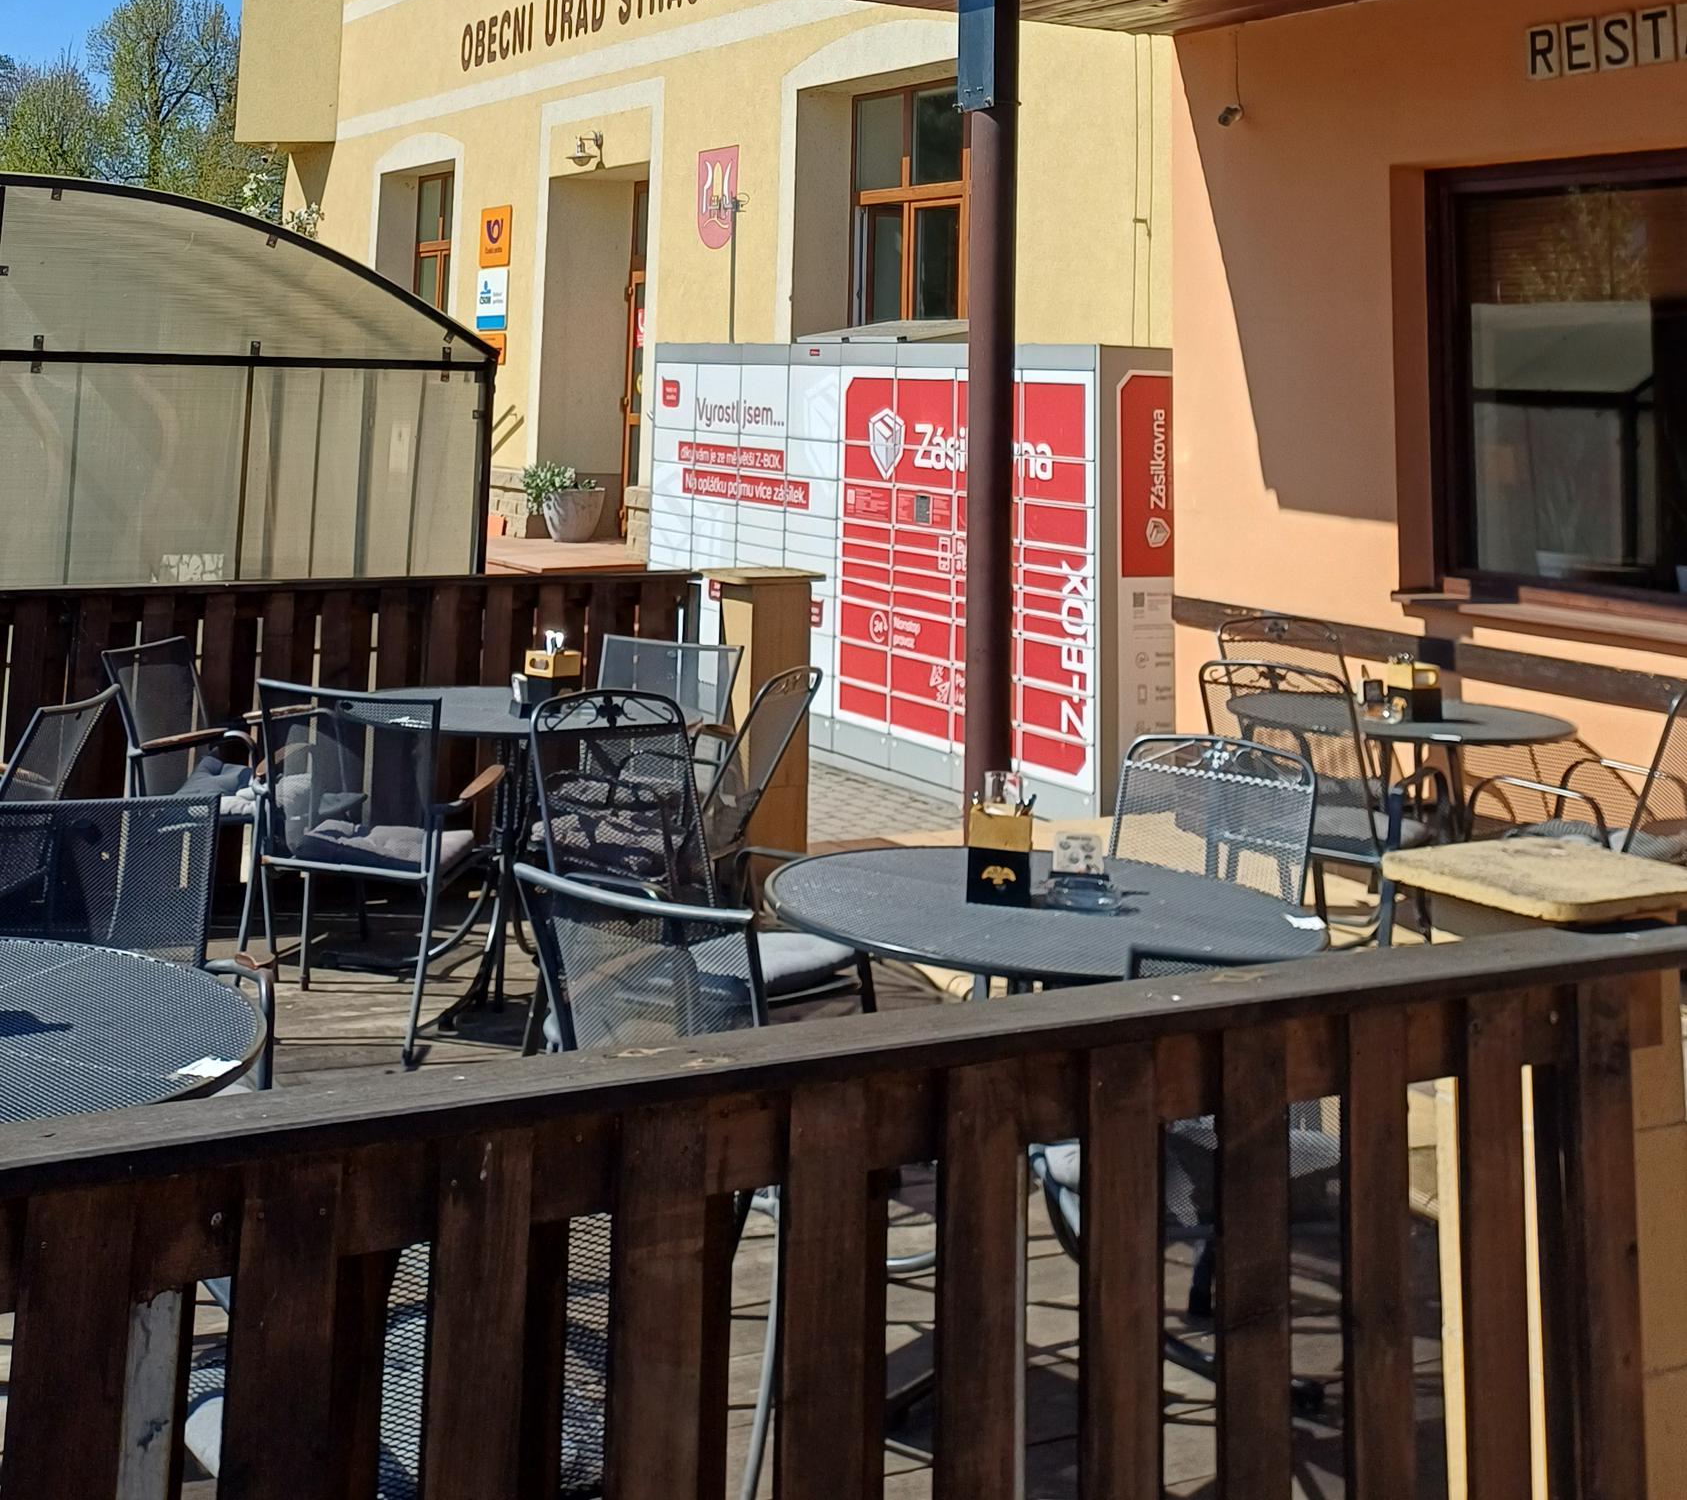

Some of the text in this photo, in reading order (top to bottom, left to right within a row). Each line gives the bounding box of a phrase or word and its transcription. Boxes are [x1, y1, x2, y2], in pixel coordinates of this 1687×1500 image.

[1530, 10, 1687, 76] REST
[696, 397, 785, 429] Vyrostl jsem...
[709, 449, 717, 465] je
[717, 452, 725, 464] ze
[1150, 409, 1166, 510] Zásilkovna
[698, 475, 727, 495] oplátku
[755, 482, 773, 500] více
[1061, 556, 1088, 739] Z-BOX
